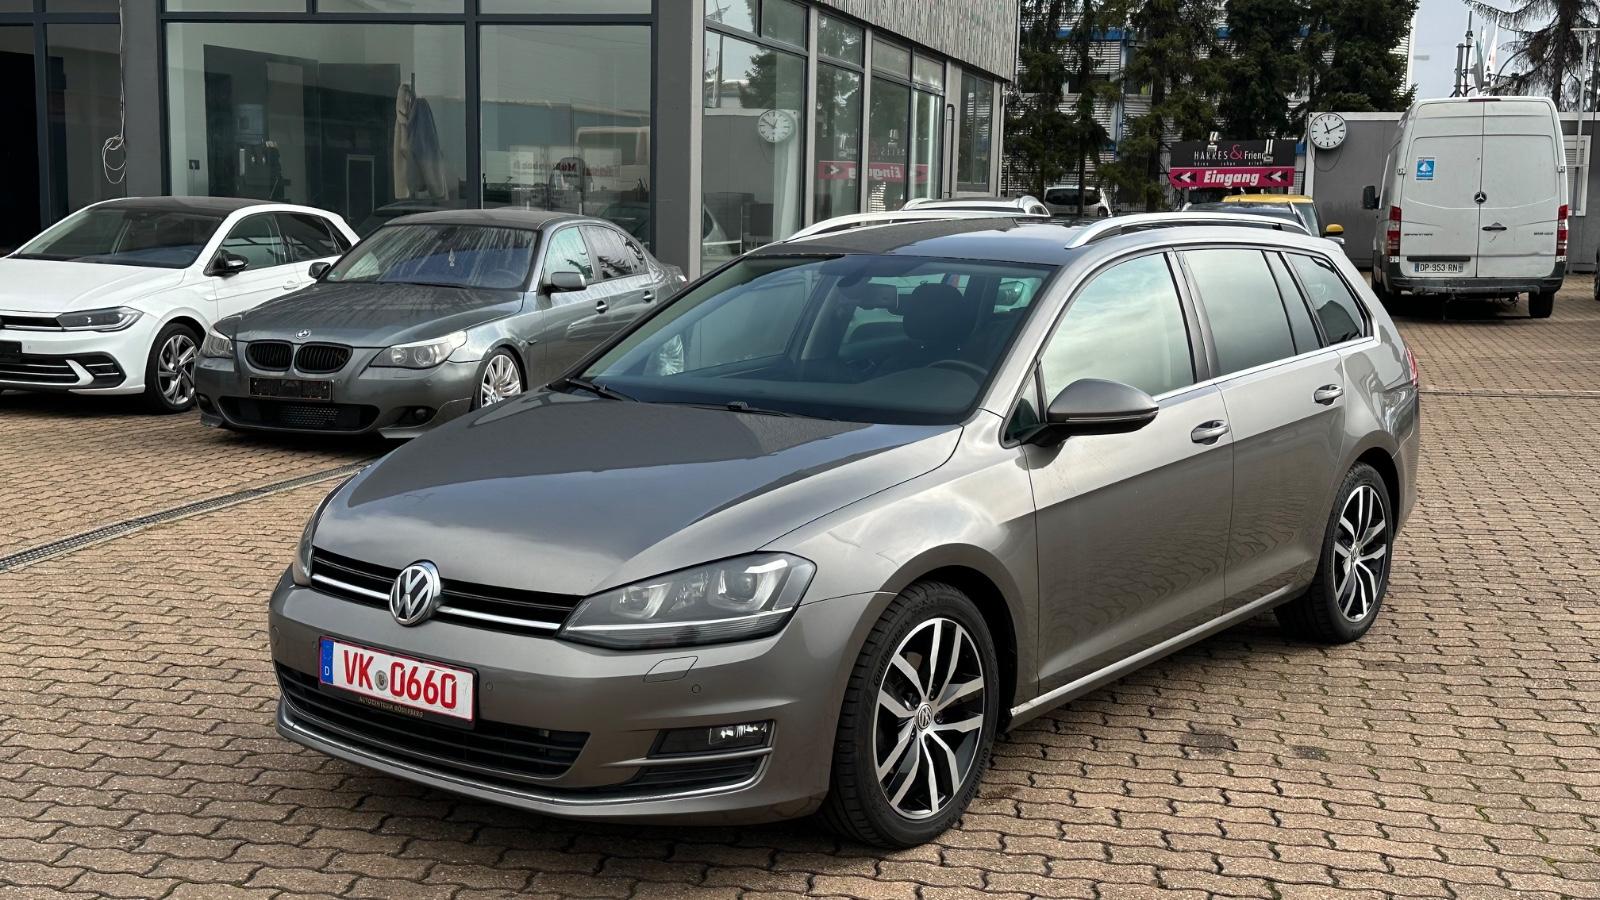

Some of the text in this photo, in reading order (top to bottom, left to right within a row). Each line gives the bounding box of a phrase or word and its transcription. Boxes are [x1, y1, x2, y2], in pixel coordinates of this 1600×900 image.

[1230, 144, 1242, 160] &
[1203, 170, 1260, 186] Eingang
[324, 665, 330, 676] D
[343, 649, 457, 710] VK 0660
